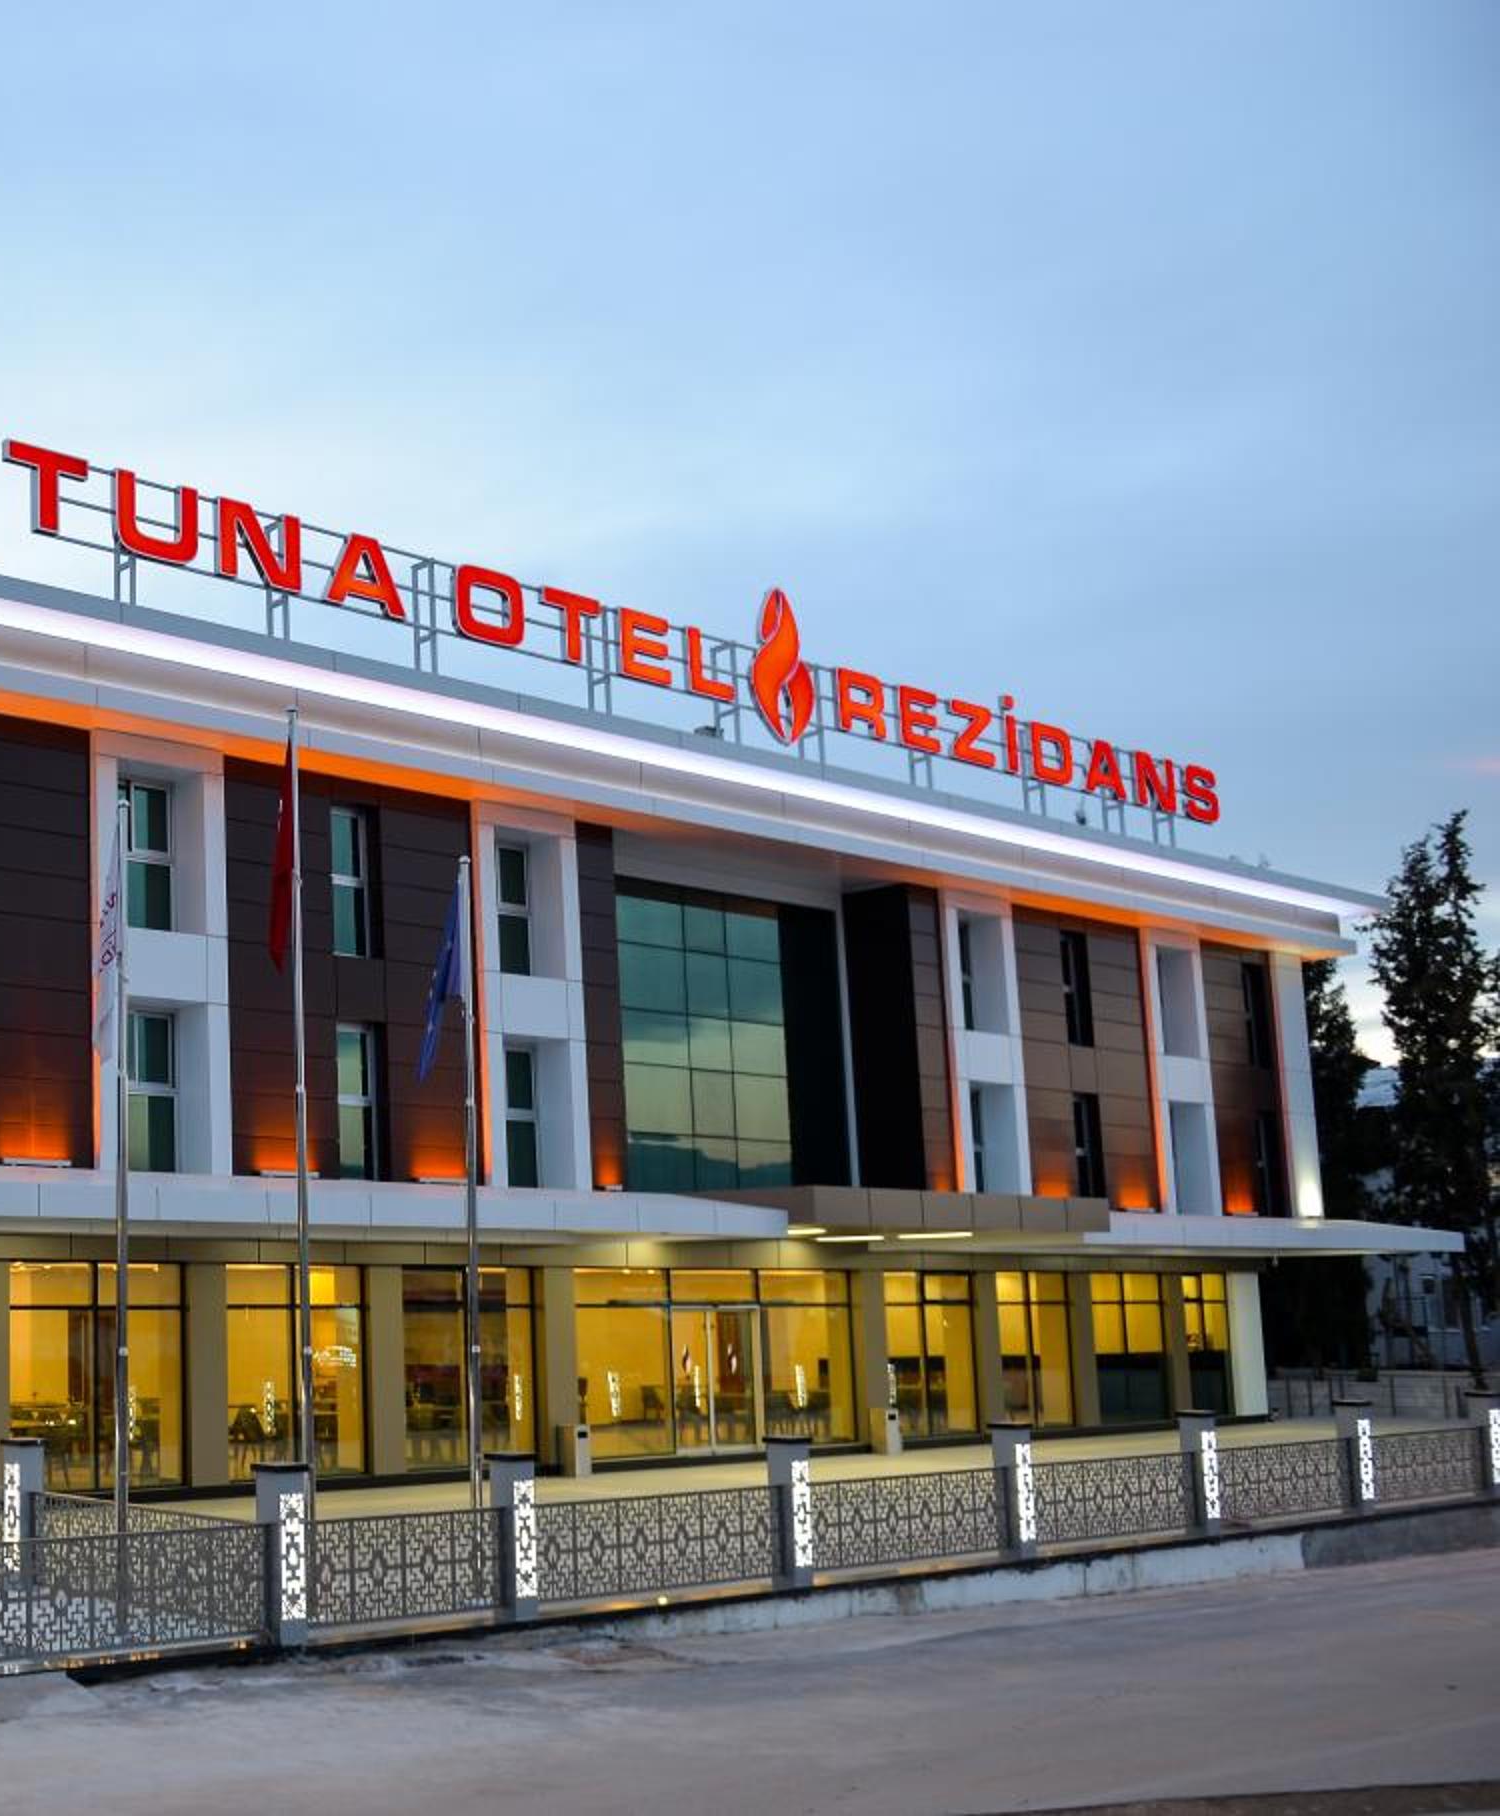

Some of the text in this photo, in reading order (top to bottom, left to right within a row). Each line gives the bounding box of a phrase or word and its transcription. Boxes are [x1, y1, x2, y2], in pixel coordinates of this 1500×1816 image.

[2, 438, 1221, 825] TUNA OTEL REZİDANS
